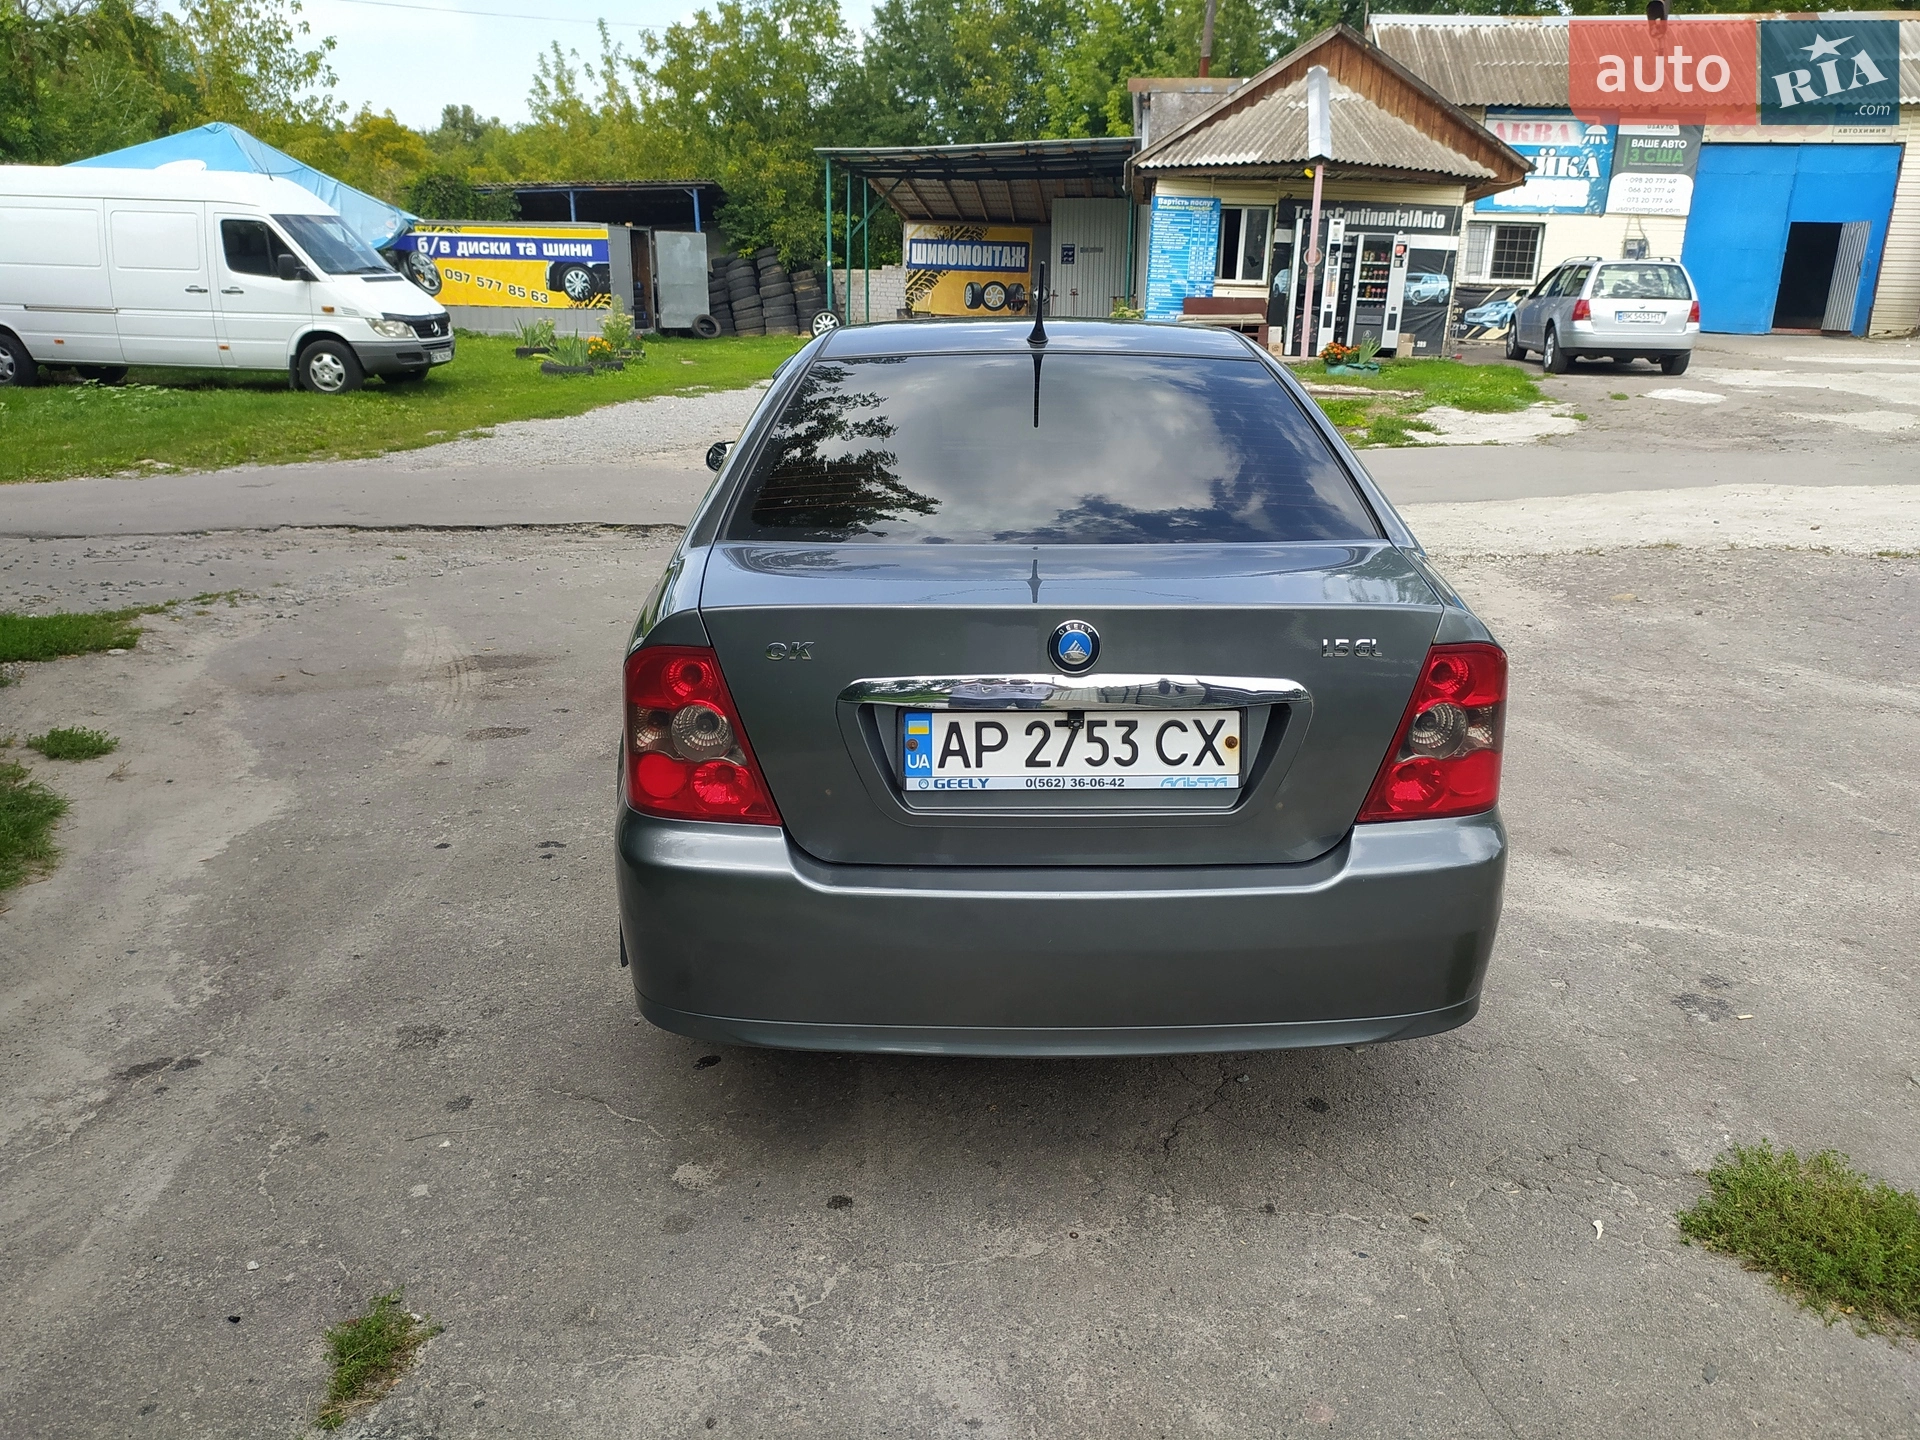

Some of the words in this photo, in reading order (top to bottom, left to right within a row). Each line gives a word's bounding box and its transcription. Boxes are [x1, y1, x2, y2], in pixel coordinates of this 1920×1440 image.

[1494, 122, 1570, 142] АКВА
[1631, 139, 1659, 148] ВАШЕ
[1661, 140, 1687, 148] АВТО
[1644, 148, 1683, 162] США
[1158, 198, 1189, 206] Вартість
[1294, 206, 1446, 229] TrnsContinentalAuto
[417, 237, 450, 254] б/в
[457, 240, 510, 256] диски
[516, 242, 536, 256] та
[543, 243, 592, 257] шини
[911, 243, 1026, 268] ШИНОМОНТАЖ
[444, 268, 470, 283] 097
[476, 276, 502, 291] 577
[508, 285, 526, 298] 85
[531, 290, 548, 303] 63
[765, 642, 814, 660] CK
[1354, 639, 1382, 657] GL
[938, 720, 1009, 769] AP
[1024, 720, 1139, 768] 2753
[1155, 720, 1226, 767] CX
[907, 754, 930, 768] UA
[934, 778, 990, 789] GEELY
[1025, 778, 1066, 789] 0(562)
[1070, 778, 1124, 788] 36-06-42
